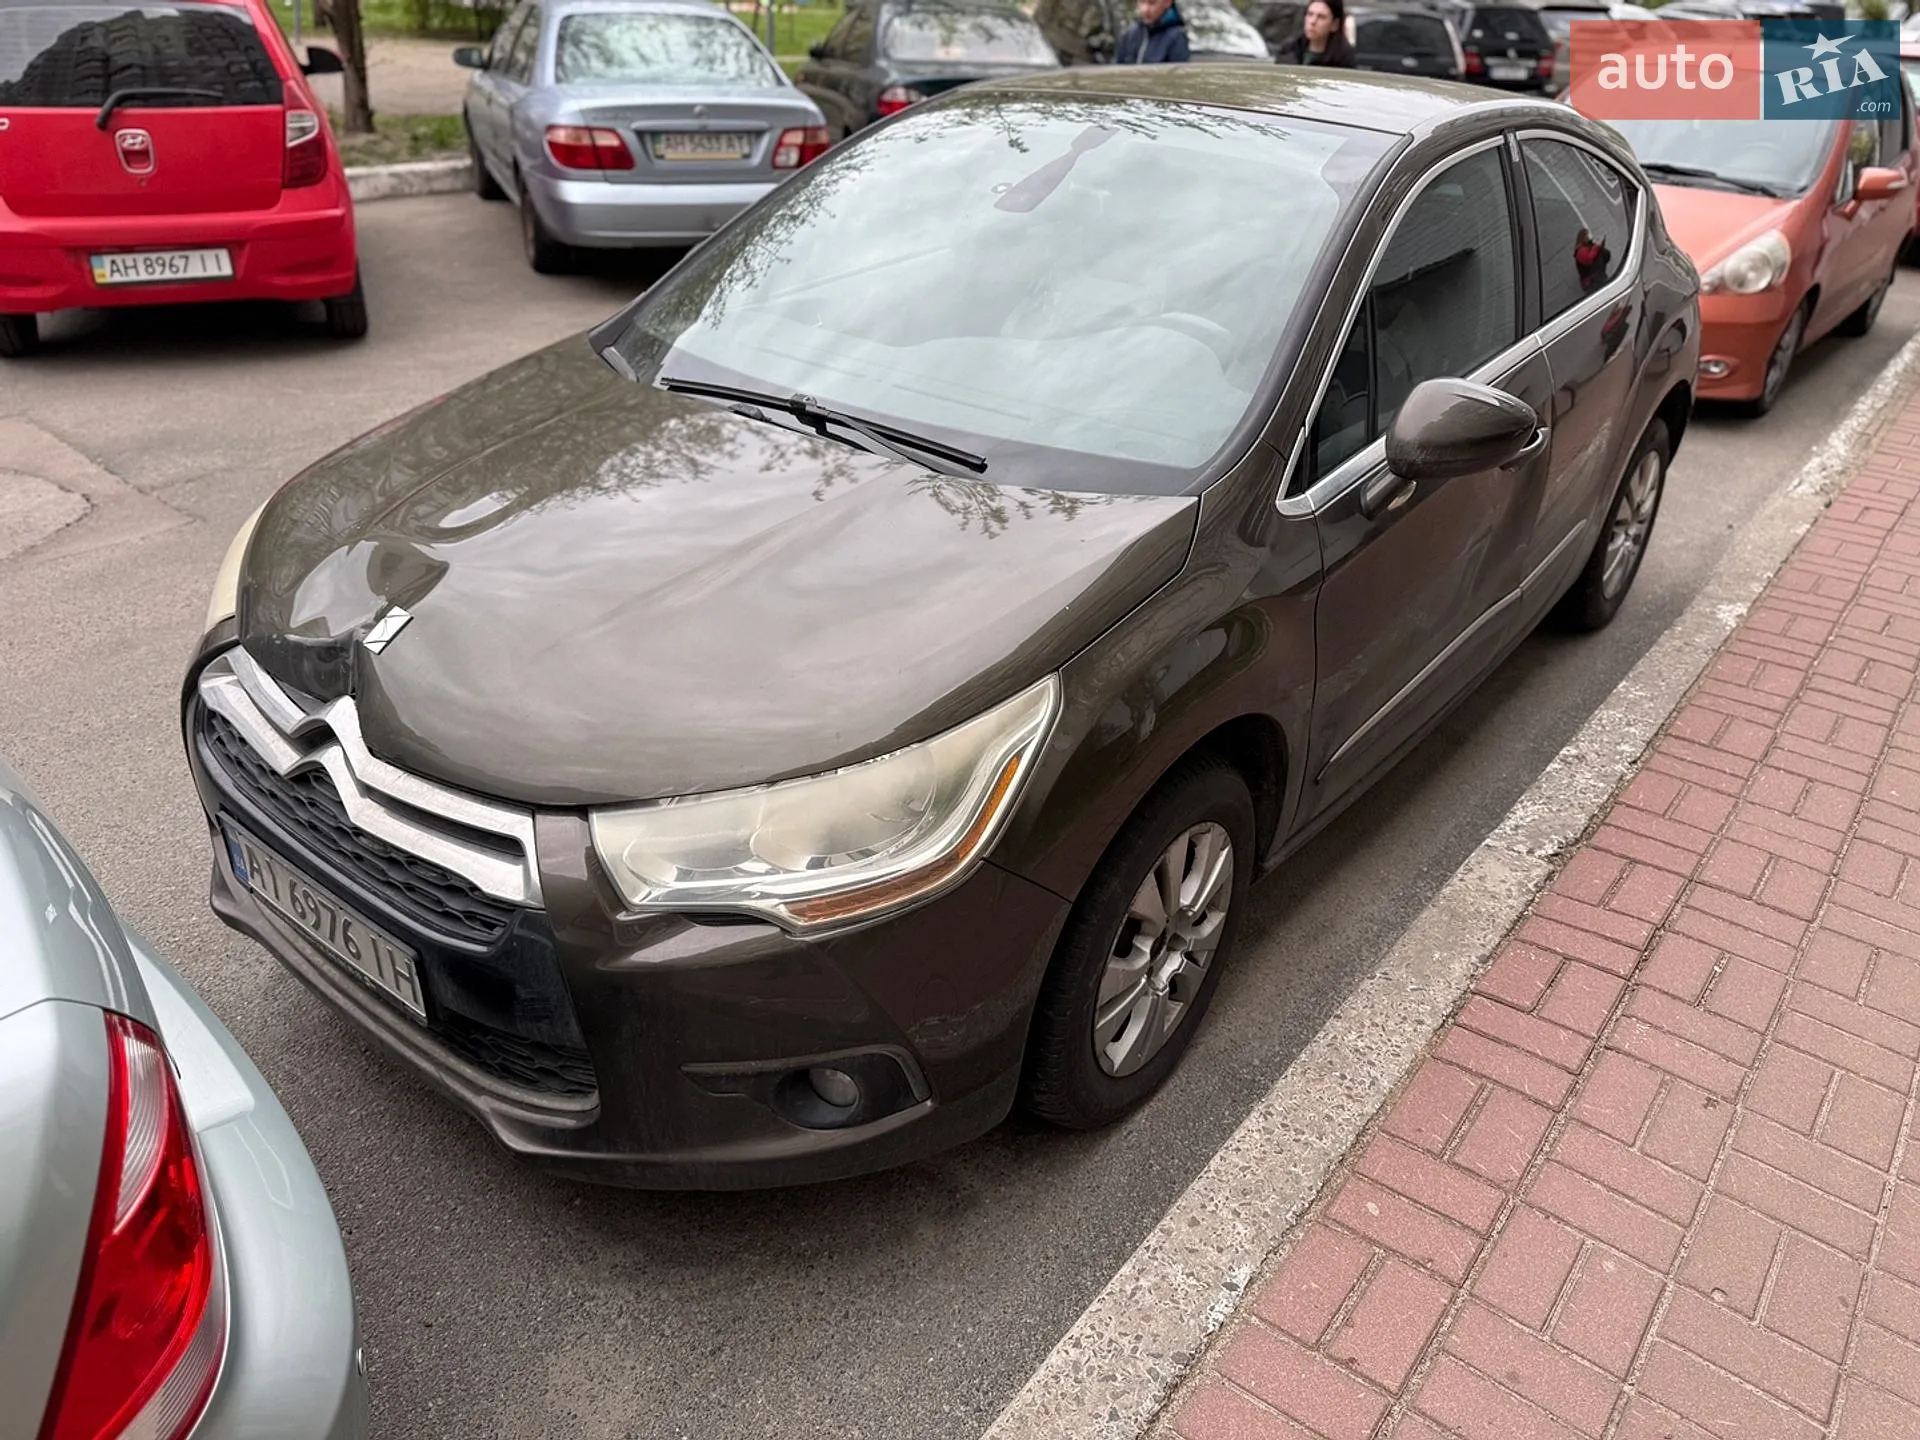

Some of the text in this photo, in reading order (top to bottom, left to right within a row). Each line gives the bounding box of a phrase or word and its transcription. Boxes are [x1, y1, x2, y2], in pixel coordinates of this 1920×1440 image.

[109, 257, 140, 278] AH
[143, 254, 190, 276] 8967
[287, 875, 362, 961] 6976
[369, 934, 419, 1006] IH
